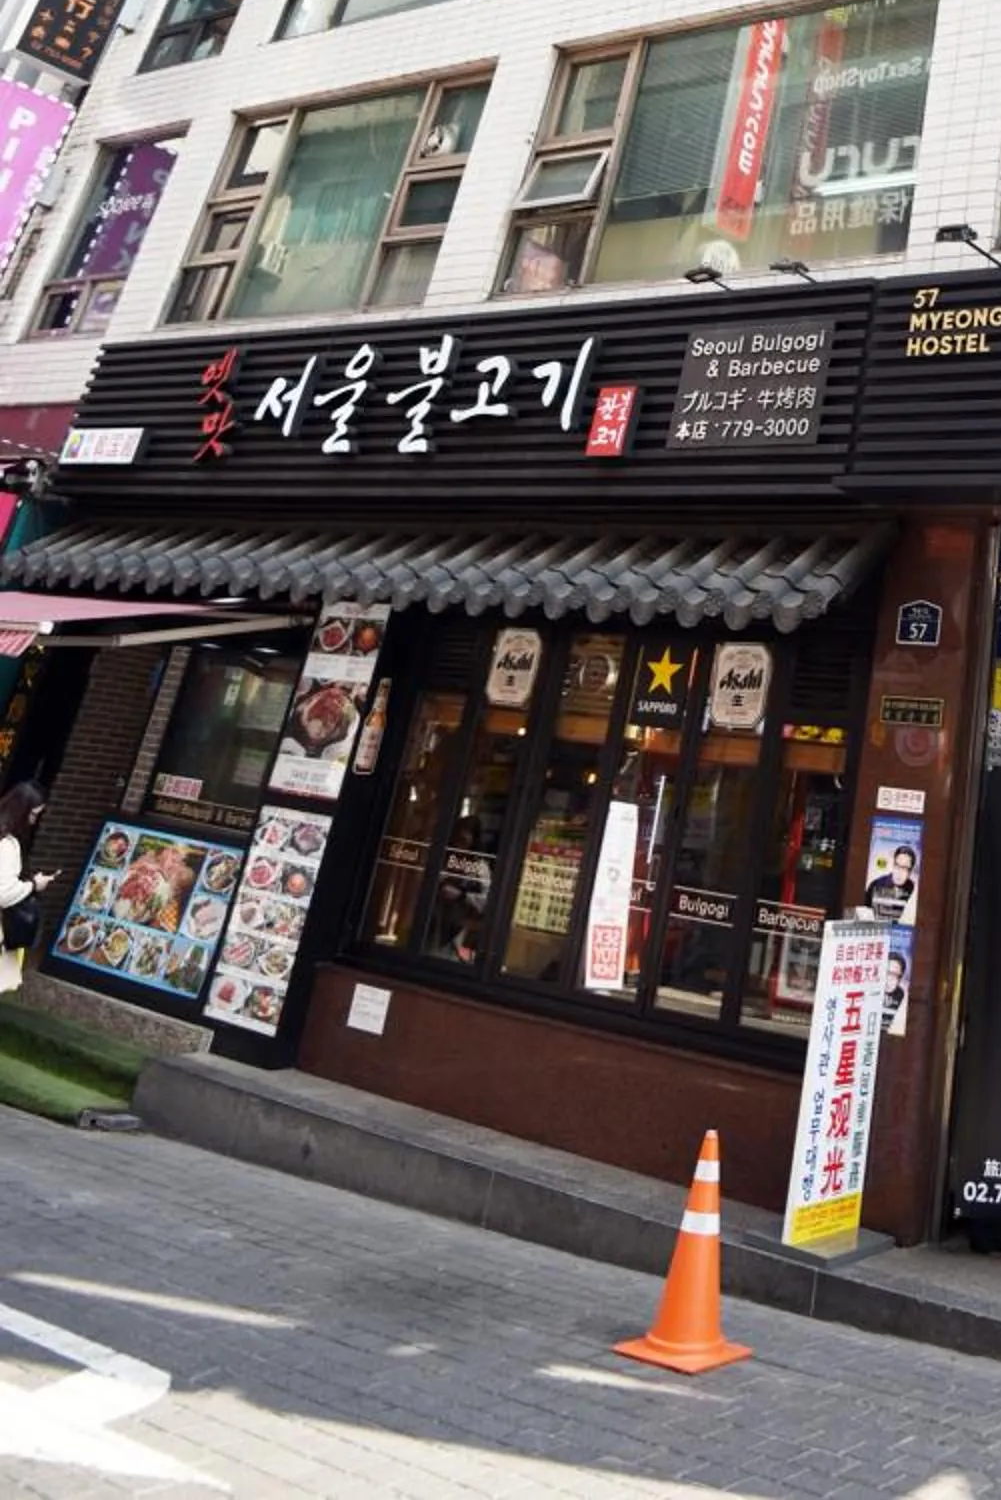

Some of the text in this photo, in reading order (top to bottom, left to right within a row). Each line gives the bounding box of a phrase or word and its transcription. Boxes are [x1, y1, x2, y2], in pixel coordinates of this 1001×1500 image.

[913, 287, 940, 309] 57
[691, 330, 825, 357] Seoul Bulgogi
[906, 333, 990, 357] HOSTEL
[706, 357, 822, 378] & Barbecue
[675, 420, 708, 441] 本店
[907, 623, 929, 640] 57
[718, 667, 764, 691] Asahi
[636, 700, 678, 715] SAPPORO
[678, 894, 730, 920] Bulgogi
[758, 907, 821, 933] Barbecue
